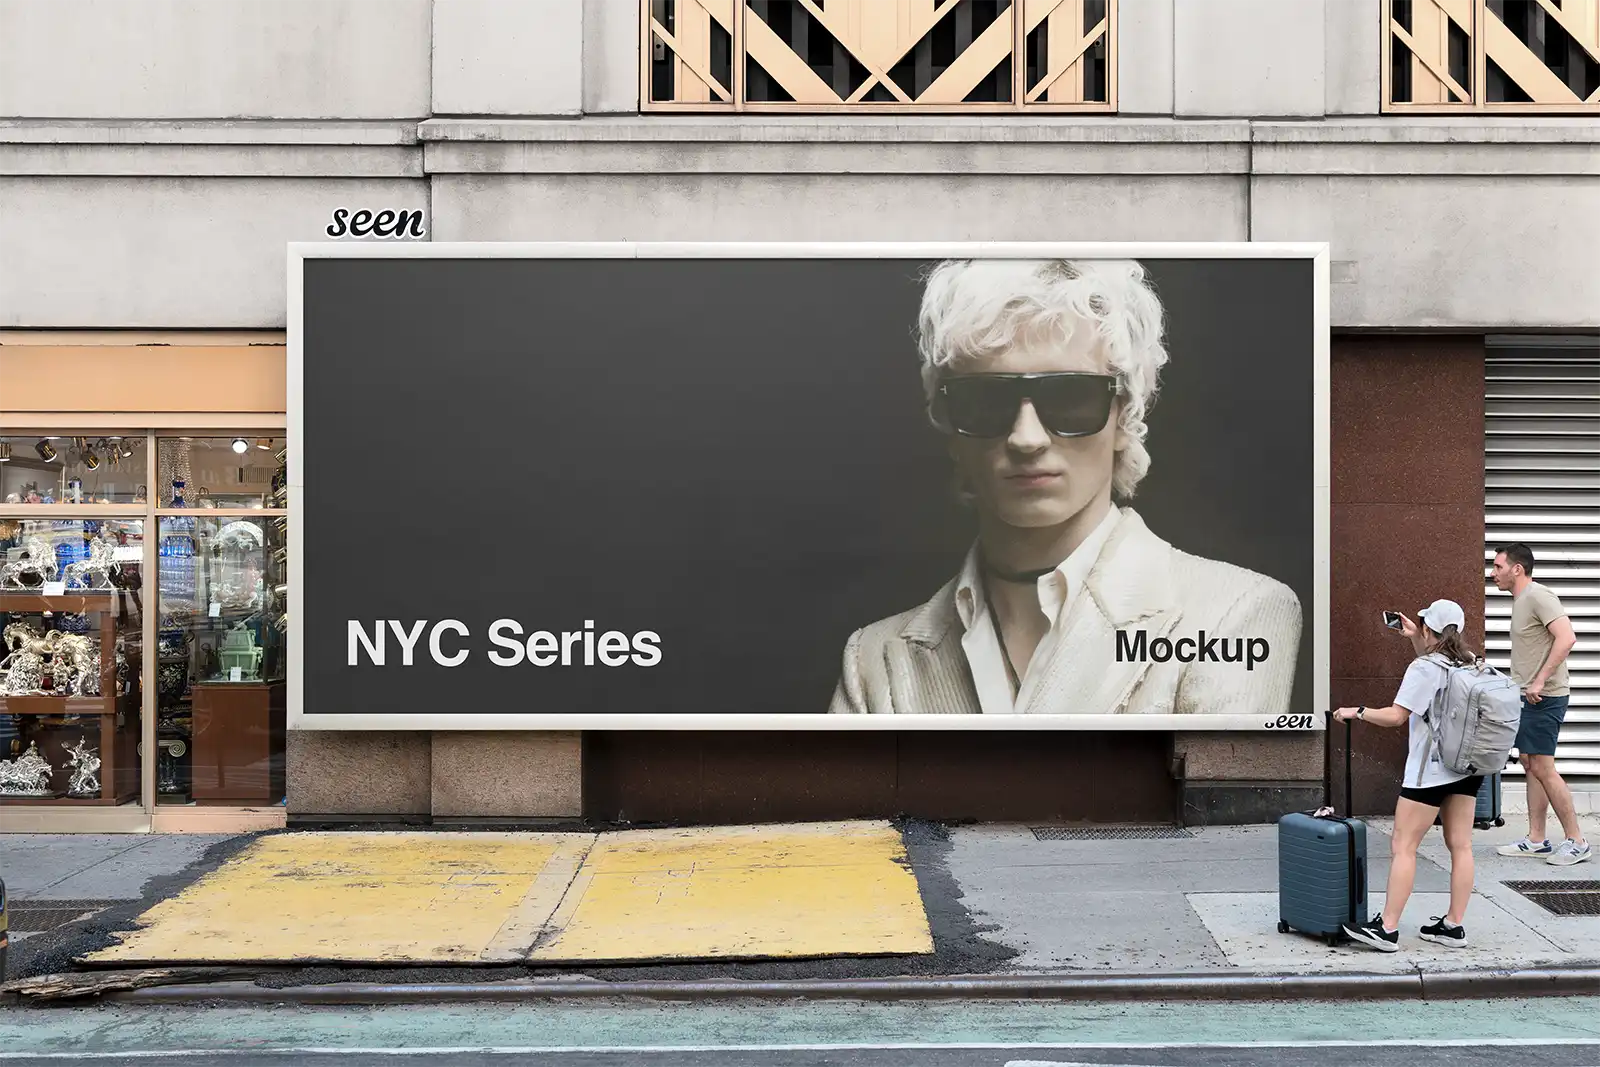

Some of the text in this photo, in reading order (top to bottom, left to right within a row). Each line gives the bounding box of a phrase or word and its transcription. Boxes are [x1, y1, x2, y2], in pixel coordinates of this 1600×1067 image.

[326, 208, 425, 237] seen
[347, 618, 662, 667] NYC Series
[1115, 629, 1270, 671] Mockup
